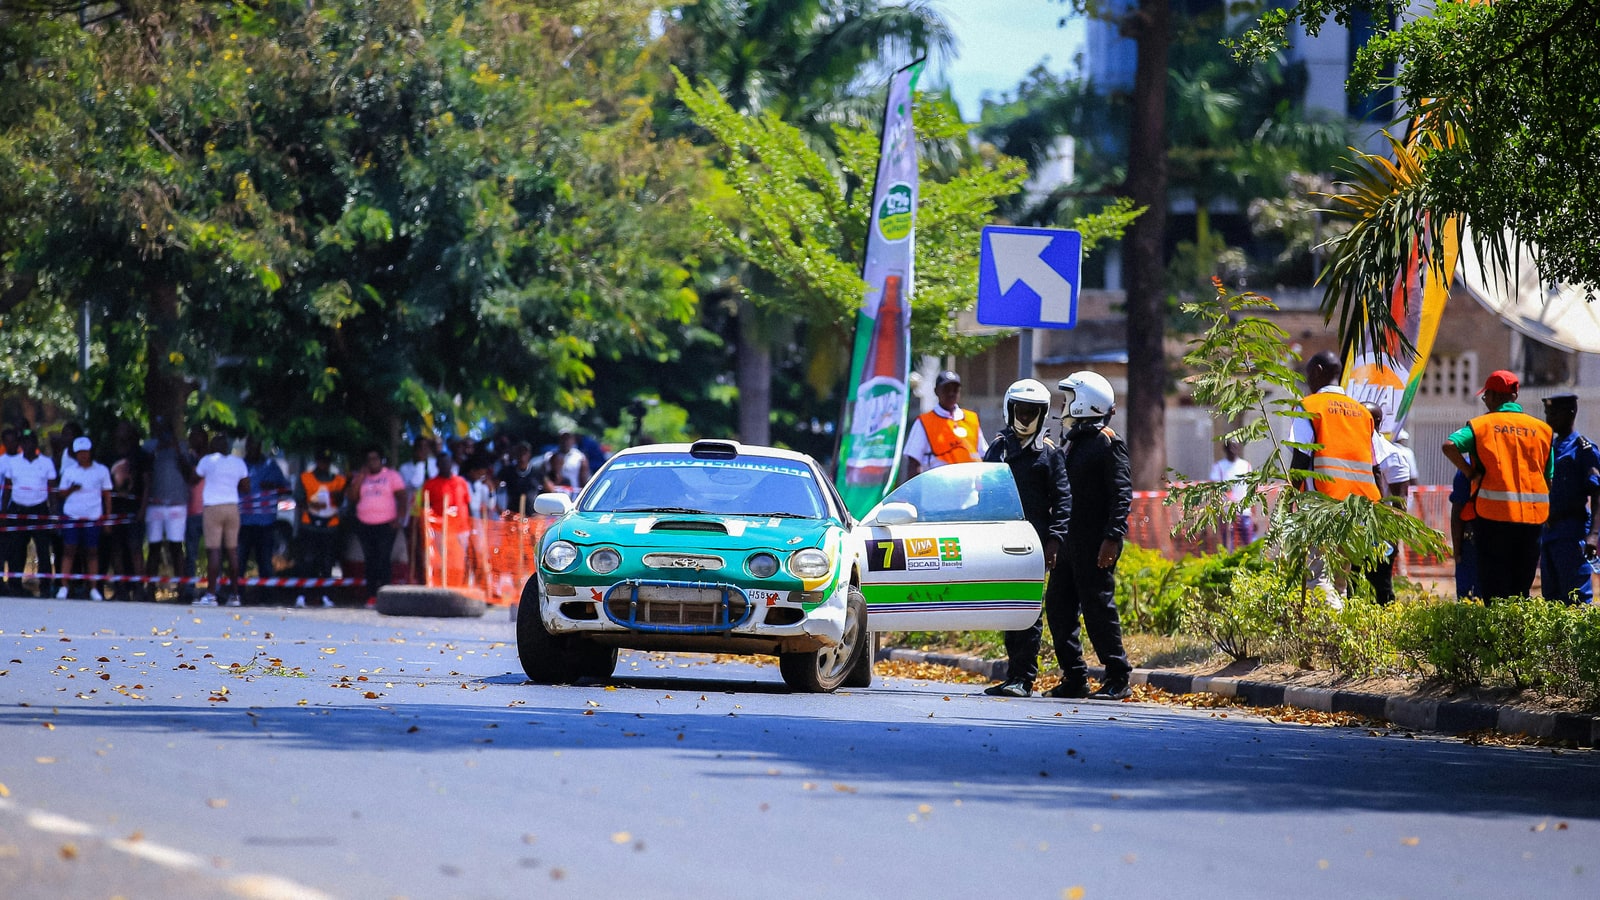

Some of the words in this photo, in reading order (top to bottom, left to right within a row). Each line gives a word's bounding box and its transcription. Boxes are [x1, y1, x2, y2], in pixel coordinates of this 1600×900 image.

[1327, 400, 1359, 409] SAFETY
[1327, 406, 1363, 417] OFFICER
[1494, 424, 1537, 437] SAFETY
[877, 541, 895, 569] 7
[944, 540, 959, 559] B
